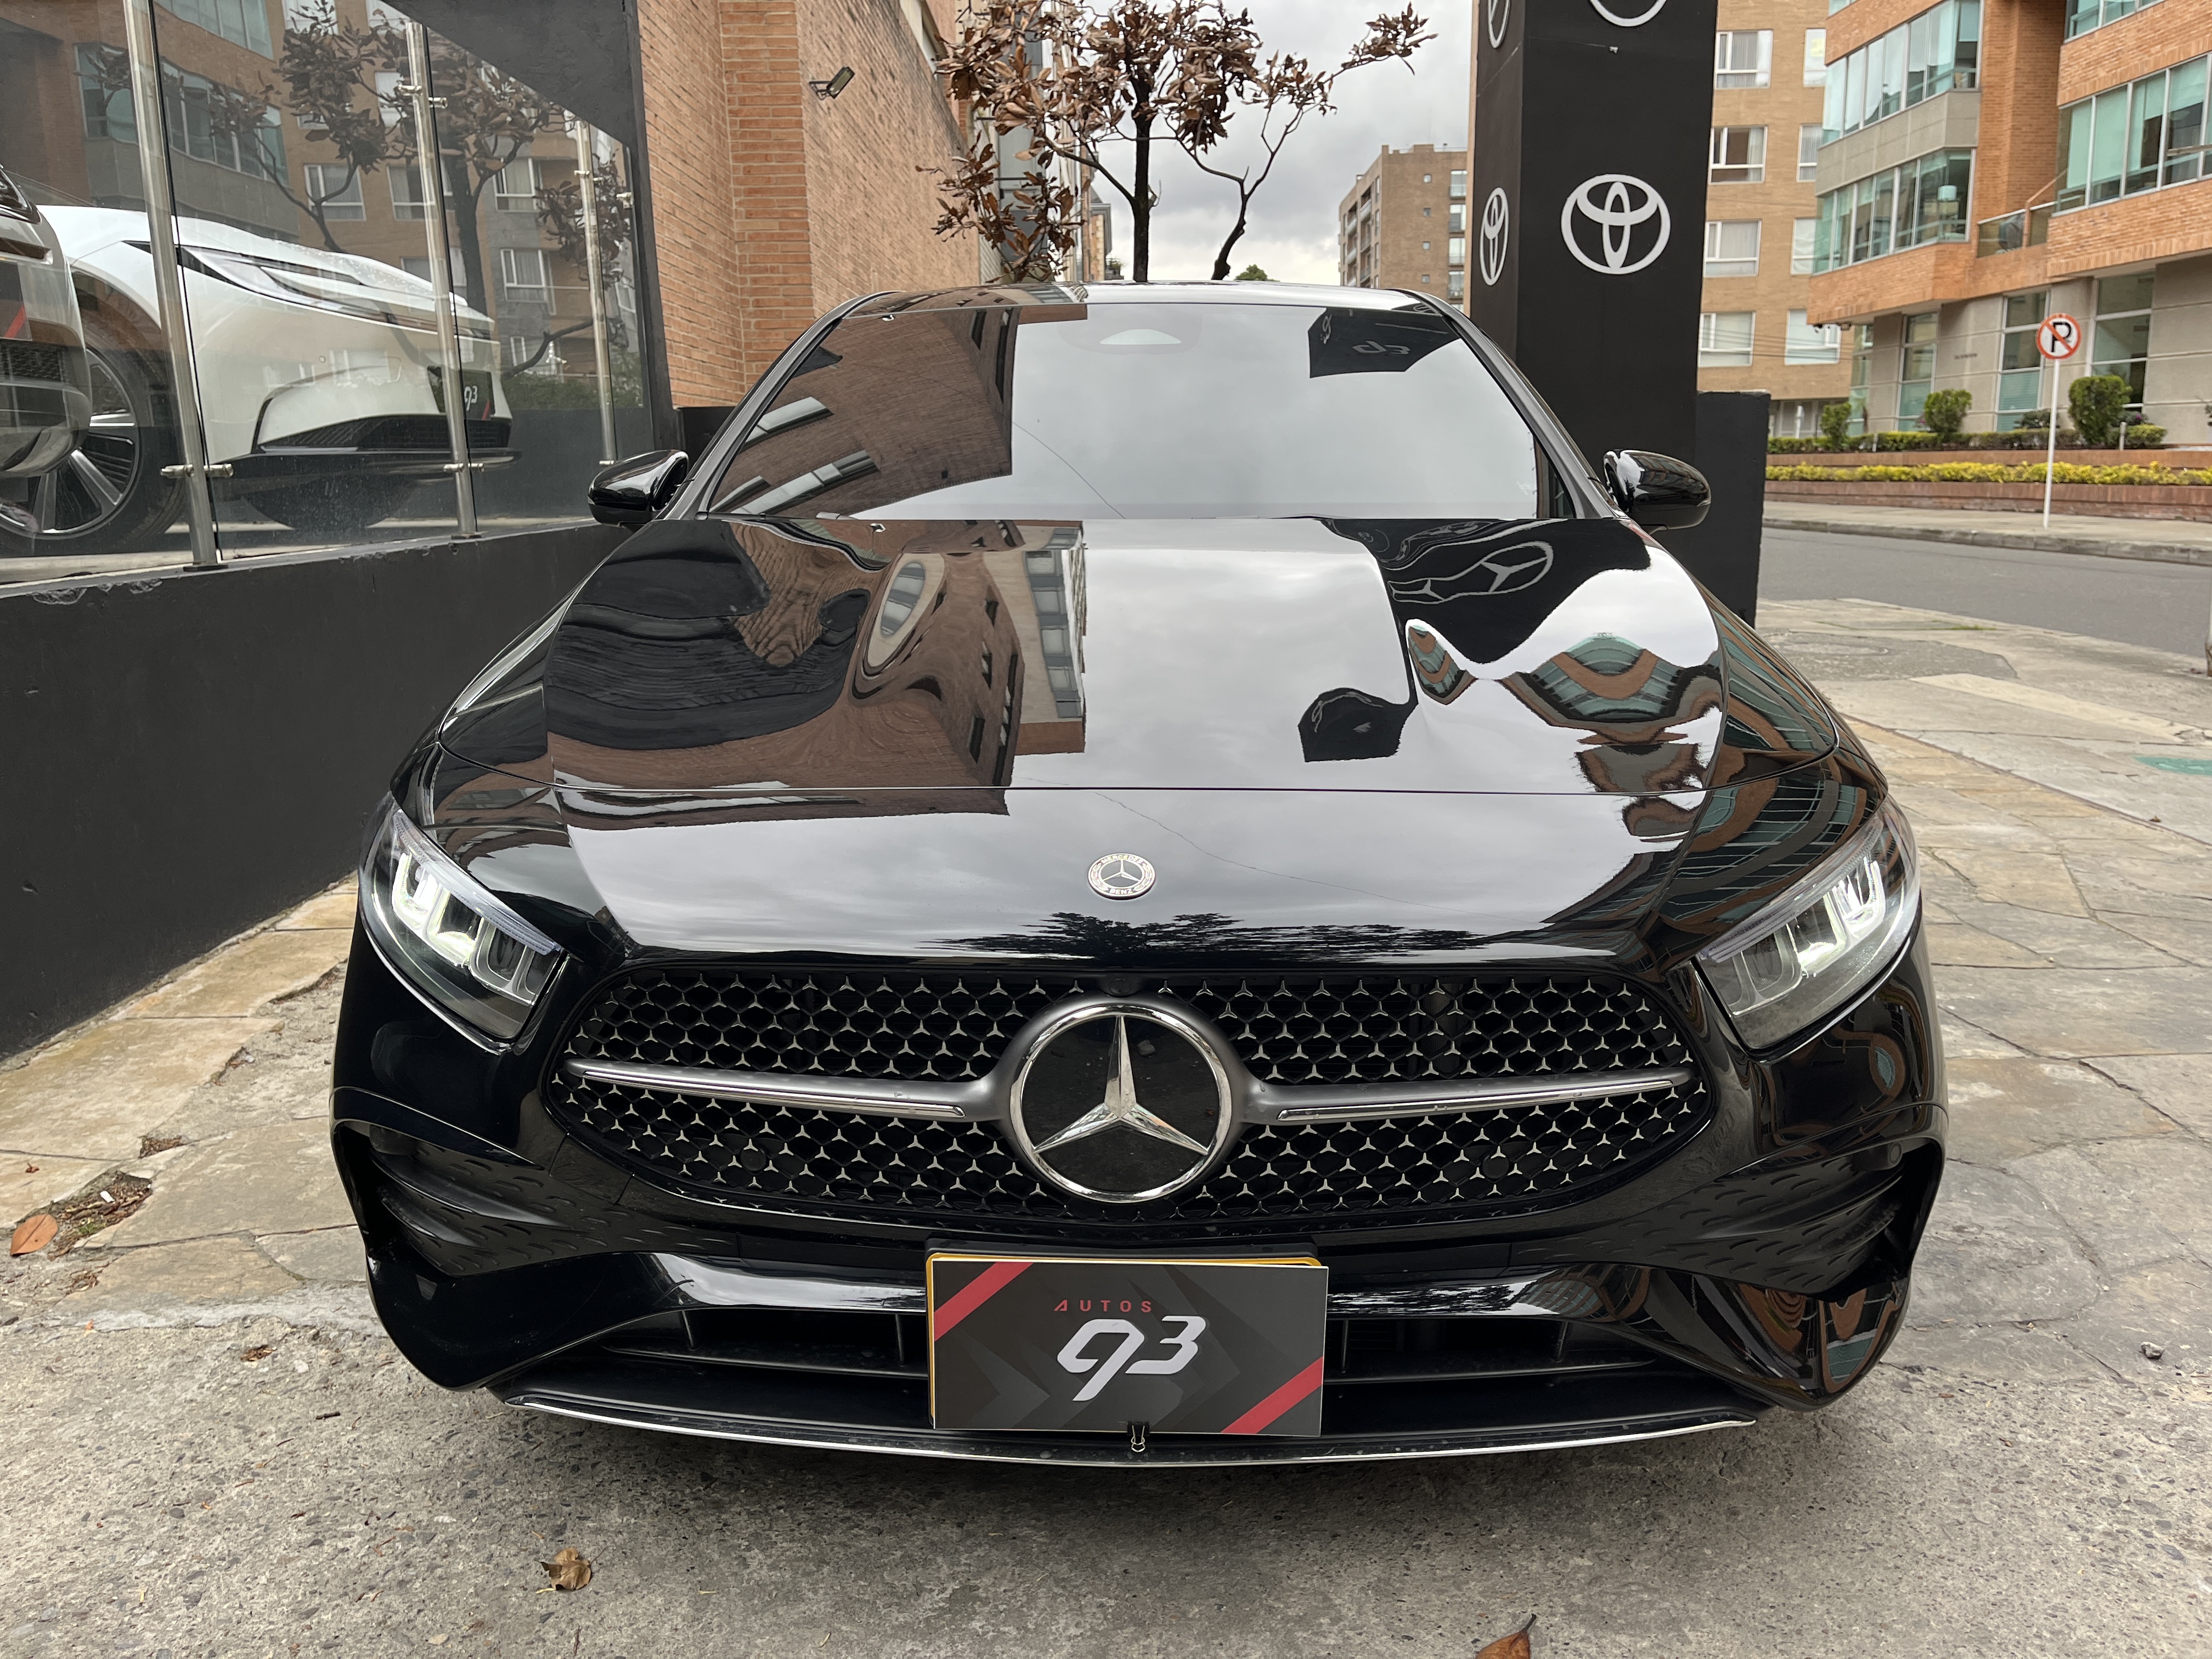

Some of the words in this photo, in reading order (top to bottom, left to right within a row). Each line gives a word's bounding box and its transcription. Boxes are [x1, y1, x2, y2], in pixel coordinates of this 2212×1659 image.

[2051, 322, 2072, 352] P
[464, 385, 477, 411] 93
[1101, 854, 1144, 865] MERCEDES
[1053, 1300, 1152, 1313] AUTOS
[1057, 1316, 1206, 1402] 93
